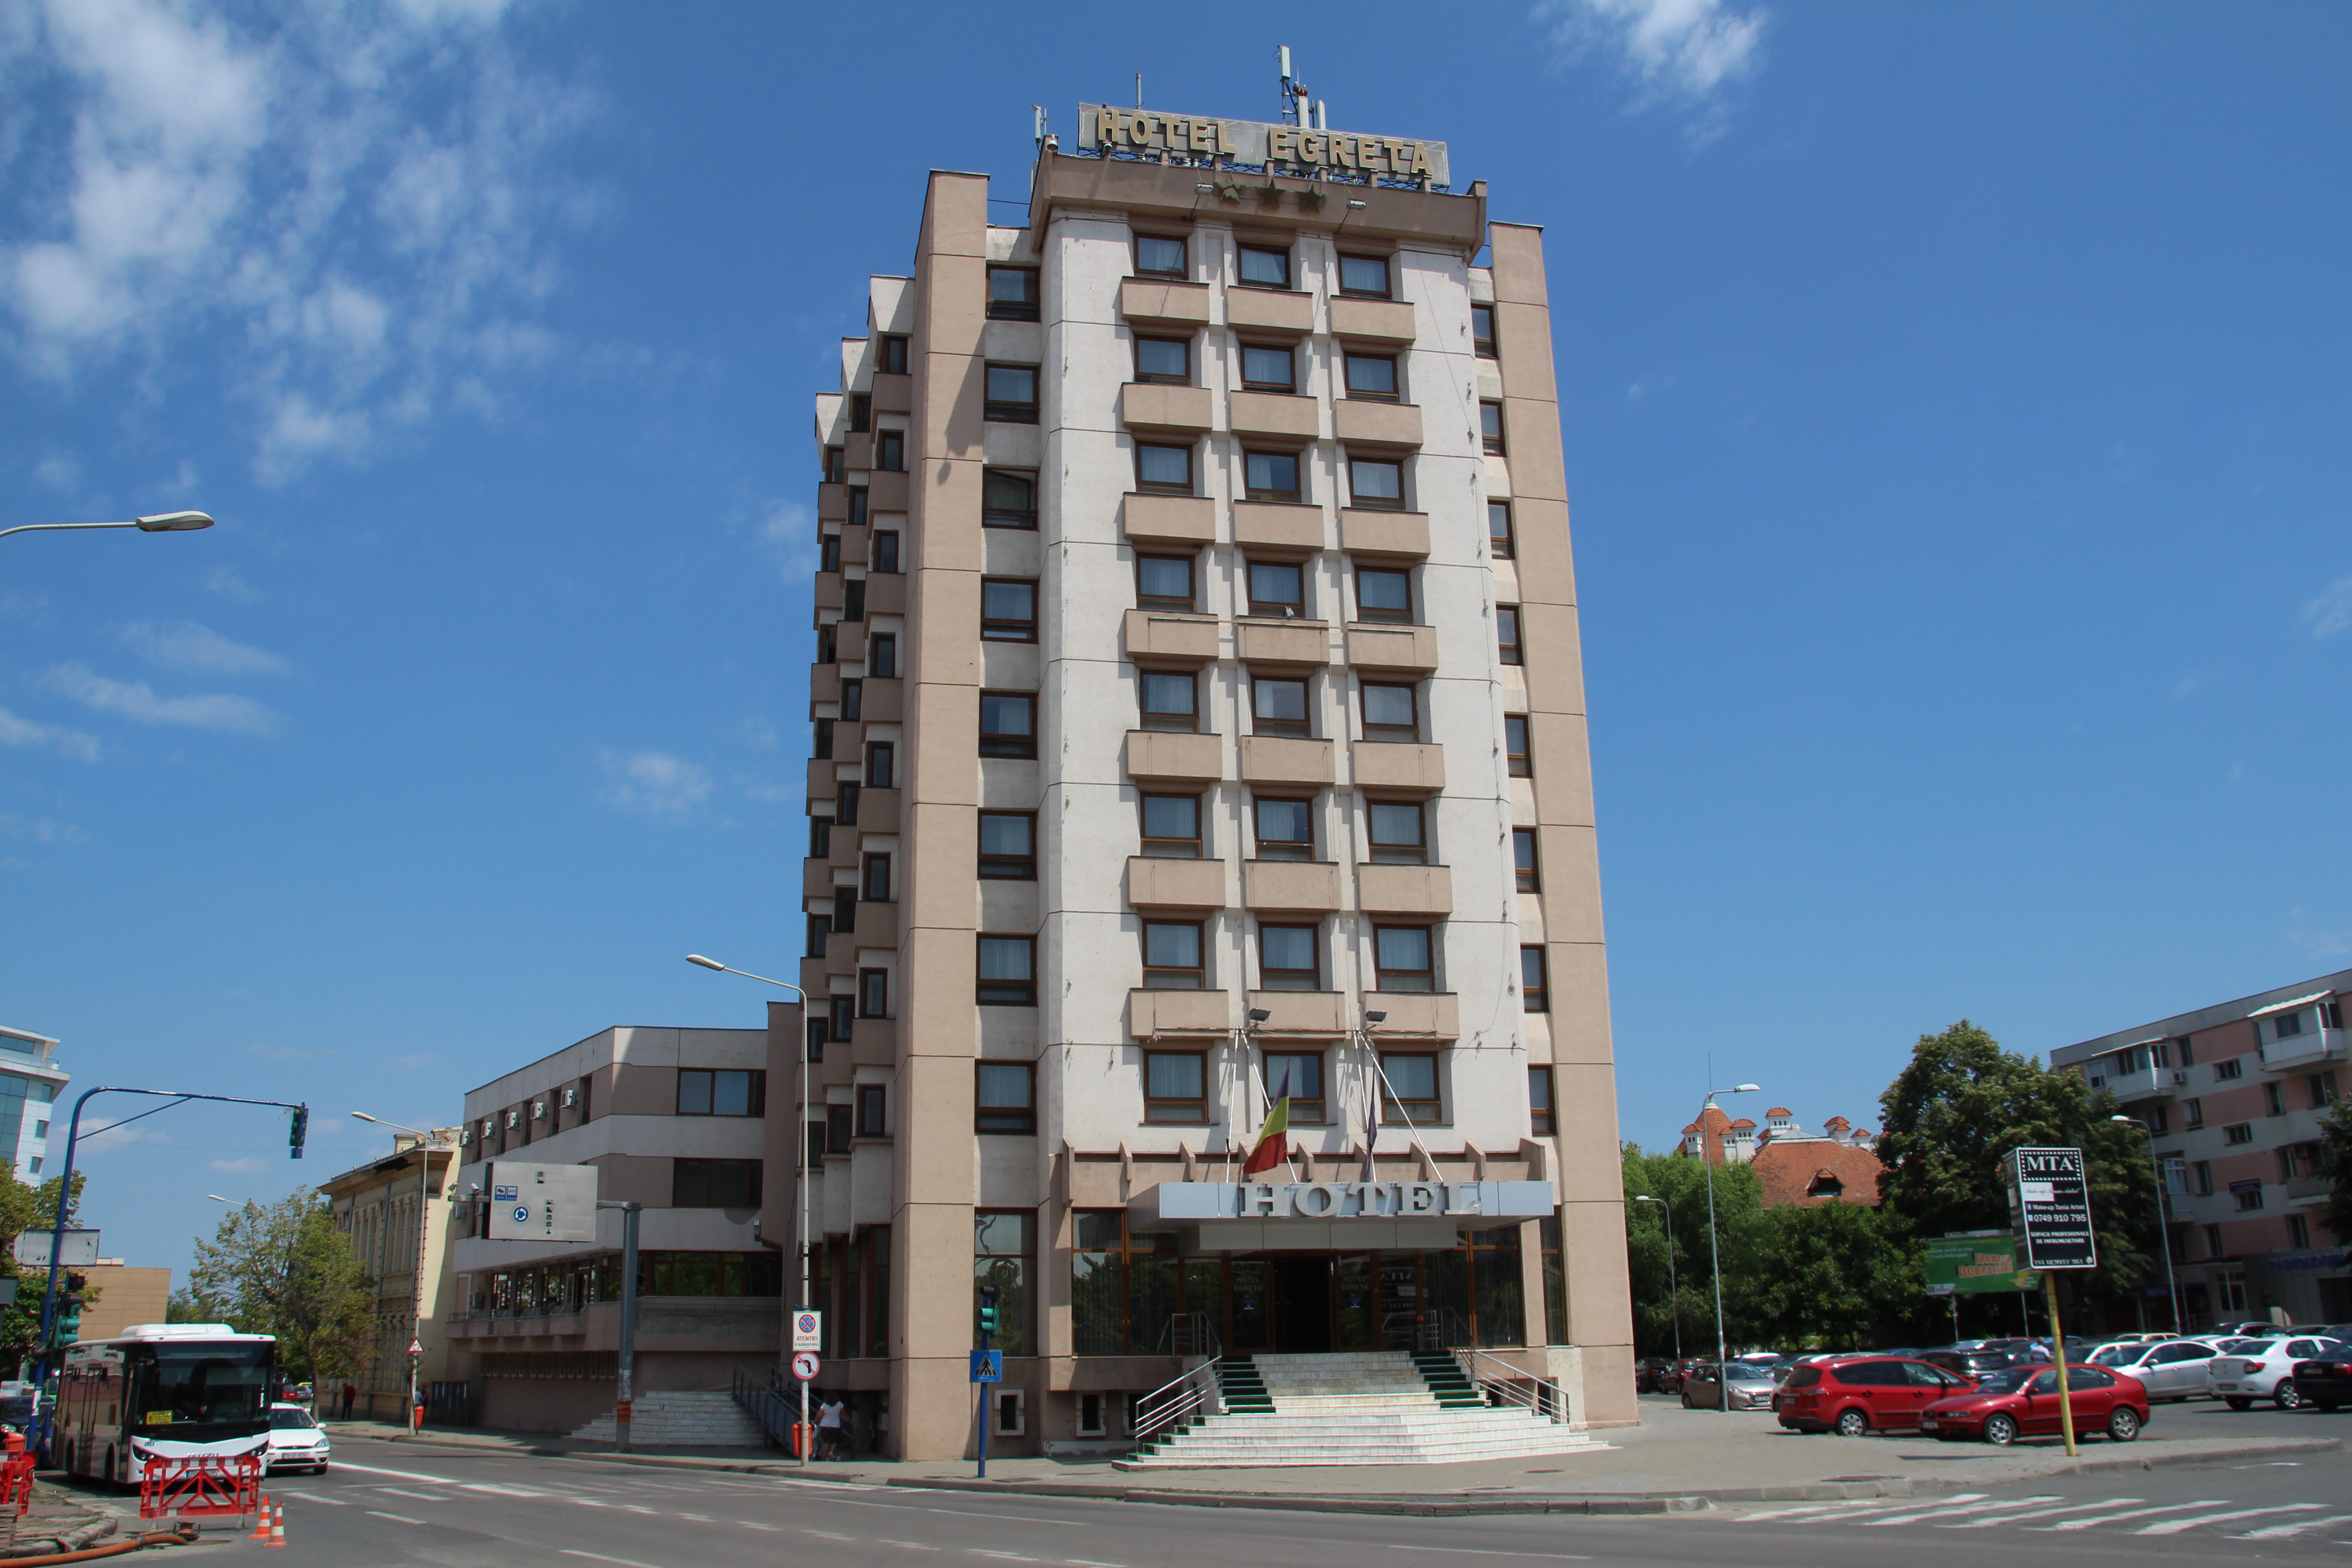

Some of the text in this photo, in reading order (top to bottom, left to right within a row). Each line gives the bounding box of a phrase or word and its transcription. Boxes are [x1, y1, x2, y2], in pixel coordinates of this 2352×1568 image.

[1098, 108, 1433, 175] HOTEL EGRETA
[2026, 1156, 2075, 1171] MTA
[1240, 1182, 1483, 1217] HOTEL
